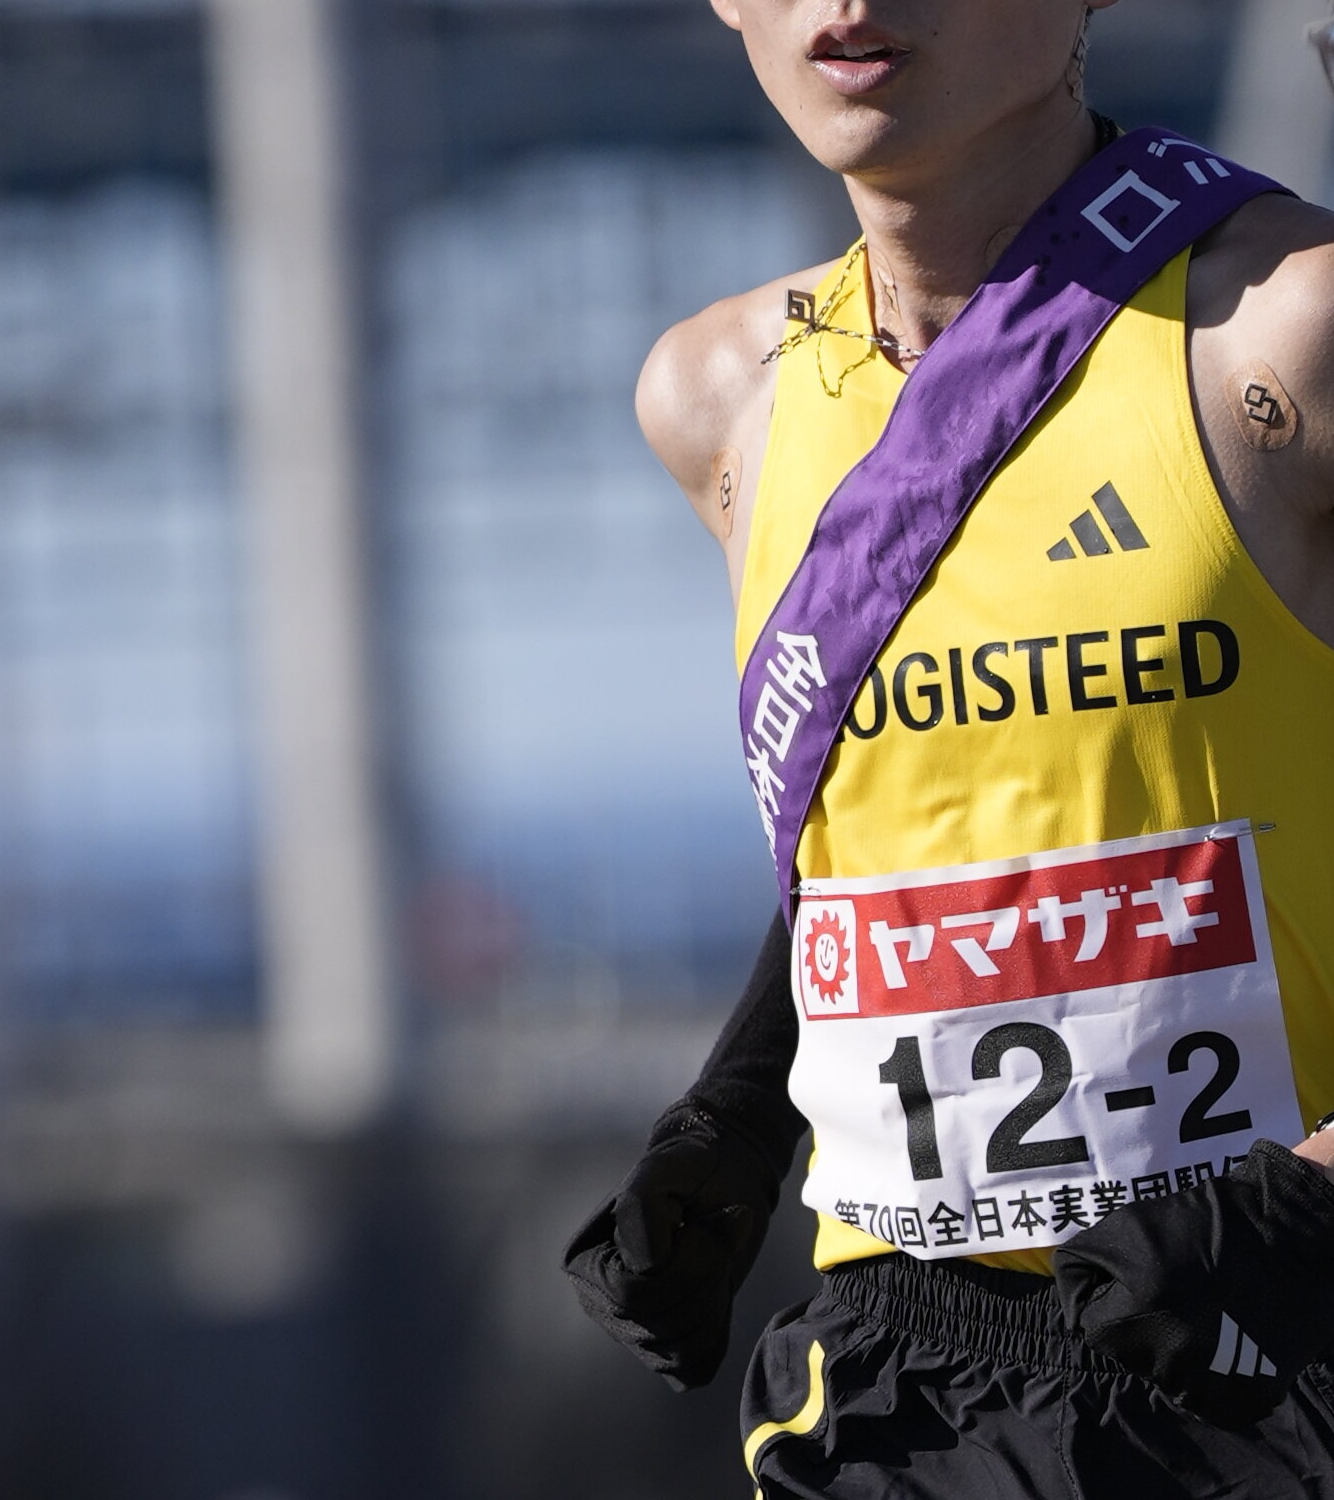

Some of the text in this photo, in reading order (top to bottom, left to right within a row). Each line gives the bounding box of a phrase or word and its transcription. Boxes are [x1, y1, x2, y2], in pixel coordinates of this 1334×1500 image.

[838, 619, 1240, 743] OGISTEED
[869, 877, 1219, 990] ヤマザキ
[878, 1021, 1253, 1181] 12-2
